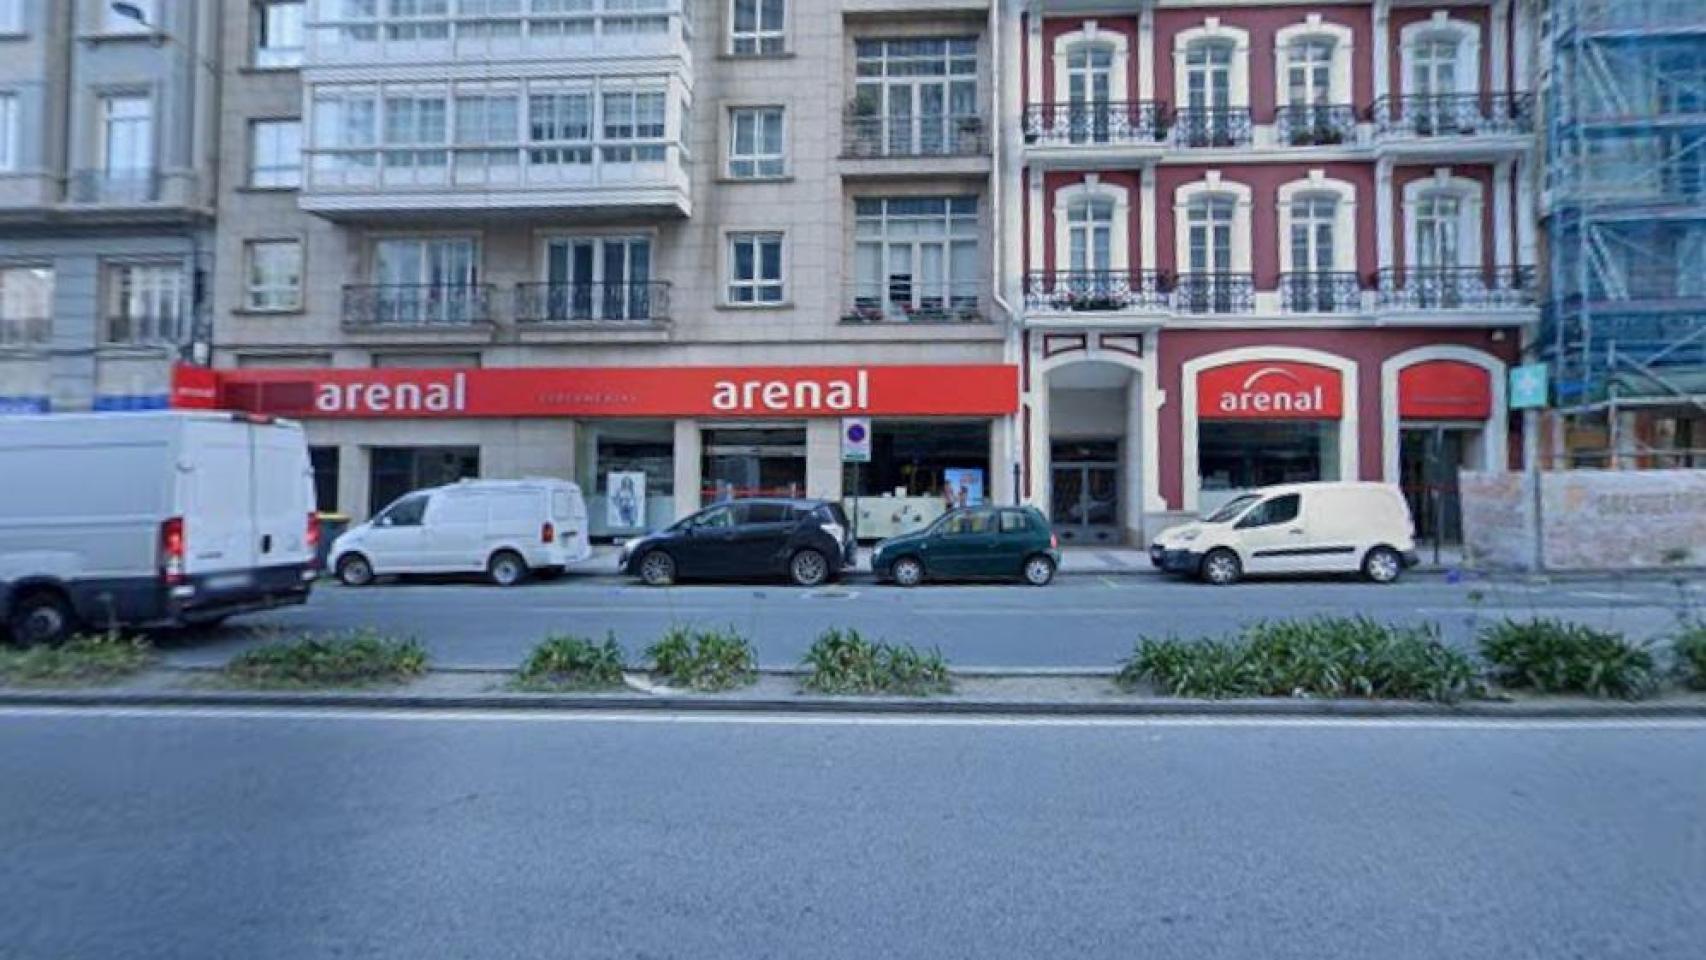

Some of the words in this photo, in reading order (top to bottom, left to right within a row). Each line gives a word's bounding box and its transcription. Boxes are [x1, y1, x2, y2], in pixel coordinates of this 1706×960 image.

[315, 373, 465, 411] arenal
[712, 370, 868, 410] arenal
[1219, 385, 1323, 412] arenal
